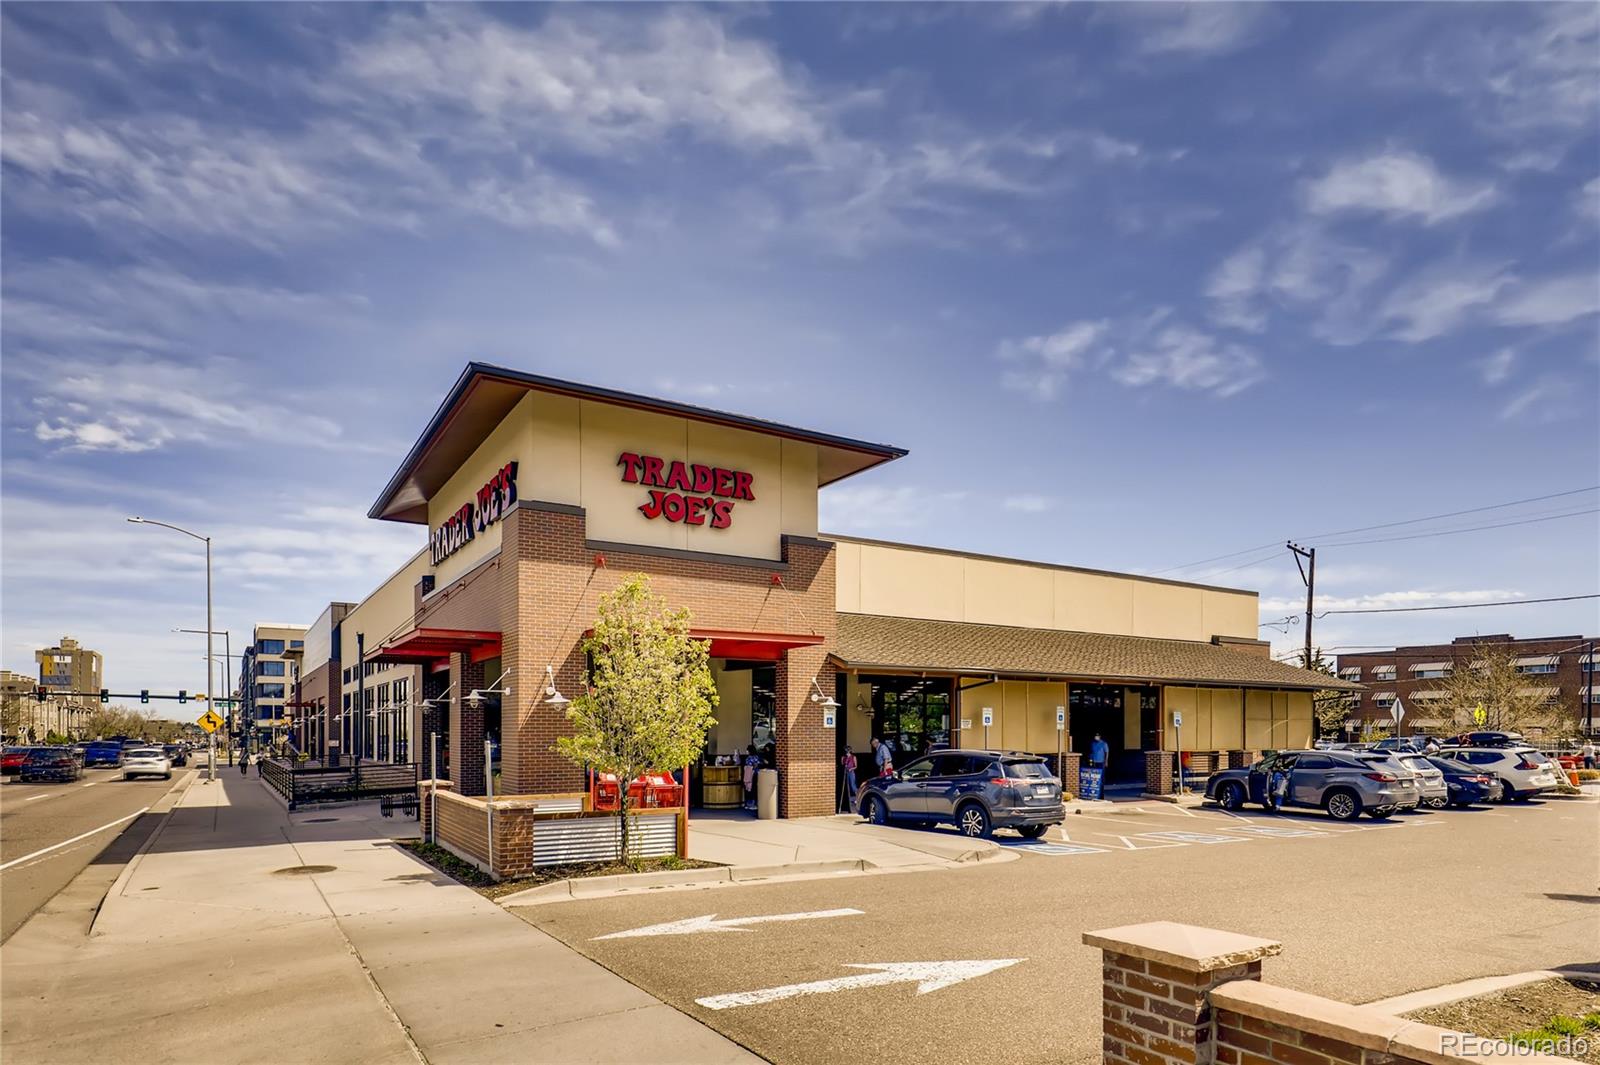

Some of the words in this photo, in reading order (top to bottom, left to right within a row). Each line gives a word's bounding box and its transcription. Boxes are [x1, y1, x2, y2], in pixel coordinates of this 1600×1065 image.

[617, 452, 755, 501] TRADER
[430, 503, 475, 567] TRADER
[475, 461, 518, 532] JOE'S
[638, 490, 735, 529] JOE'S
